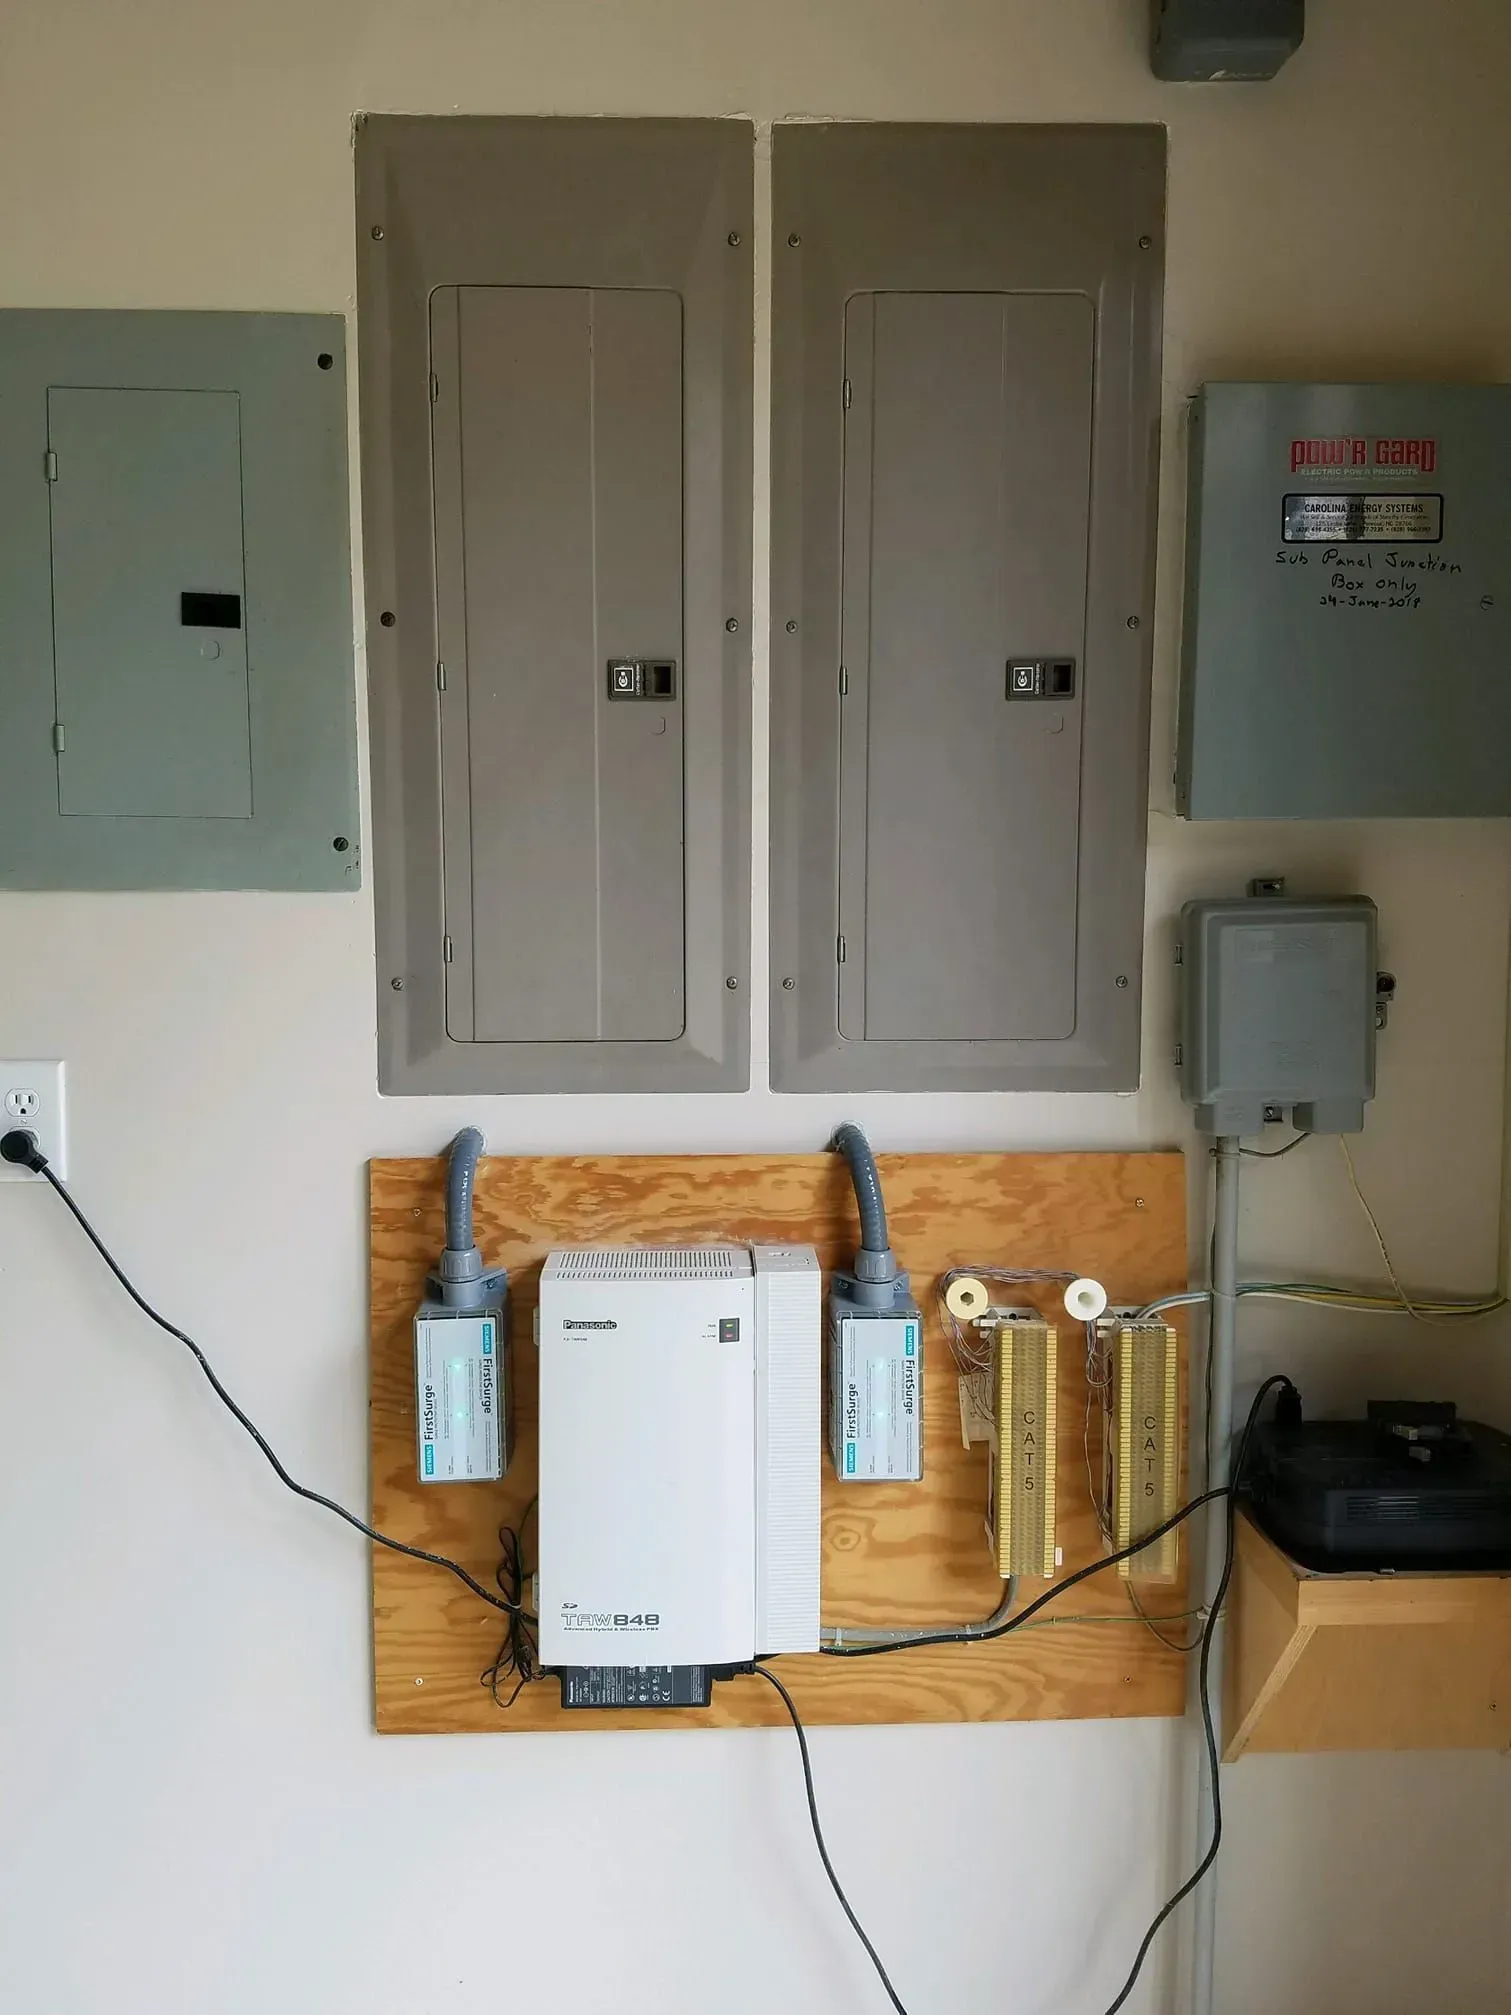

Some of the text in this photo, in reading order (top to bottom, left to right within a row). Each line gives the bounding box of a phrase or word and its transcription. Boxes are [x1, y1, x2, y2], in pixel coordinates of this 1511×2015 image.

[1301, 468, 1341, 476] ELECTRIC
[1372, 468, 1418, 476] PRODUCTS
[1304, 503, 1424, 513] CAROLINA ENERGY SYSTEMS
[1276, 549, 1462, 573] Sub Panel Junction
[1331, 573, 1364, 590] Box
[563, 1320, 617, 1329] Panasonic
[483, 1325, 491, 1354] SIEMENS
[906, 1327, 914, 1356] SIEMENS
[482, 1358, 494, 1414] FirstSurge
[904, 1359, 915, 1415] FirstSurge
[424, 1384, 436, 1440] FirstSurge
[846, 1383, 859, 1439] FirstSurge
[425, 1445, 433, 1474] SIEMENS
[847, 1444, 855, 1472] SIEMENS
[561, 1613, 660, 1626] TAW848
